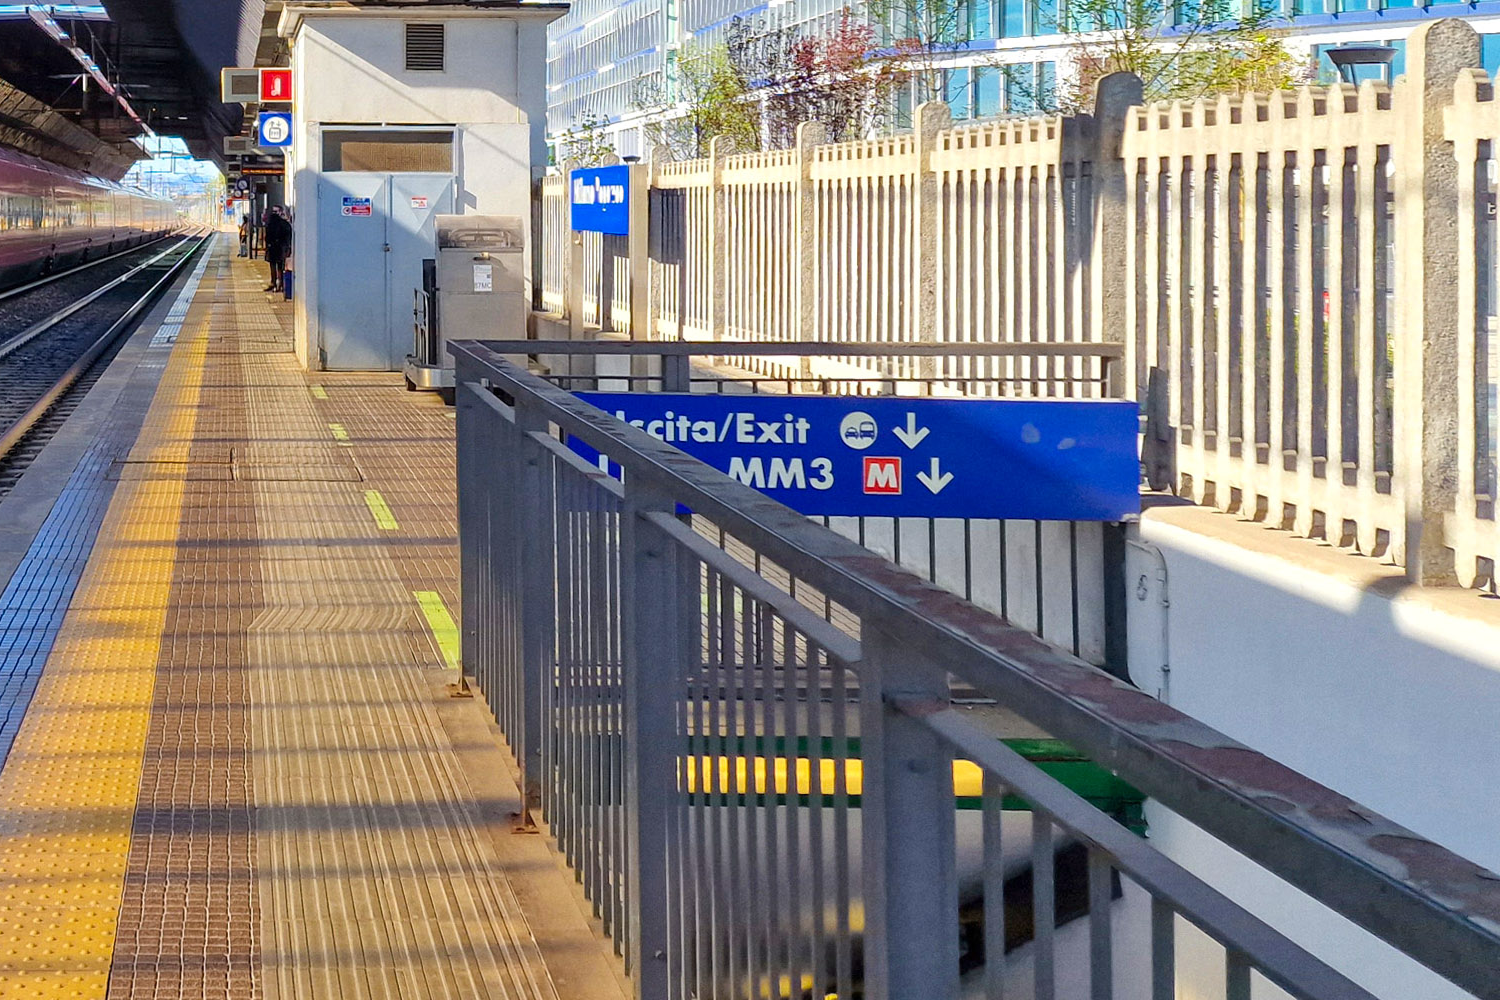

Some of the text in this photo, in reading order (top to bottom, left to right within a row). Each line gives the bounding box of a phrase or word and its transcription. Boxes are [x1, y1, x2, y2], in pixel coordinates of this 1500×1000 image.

[604, 410, 811, 444] scita/Exit
[728, 456, 899, 490] MM3 M
